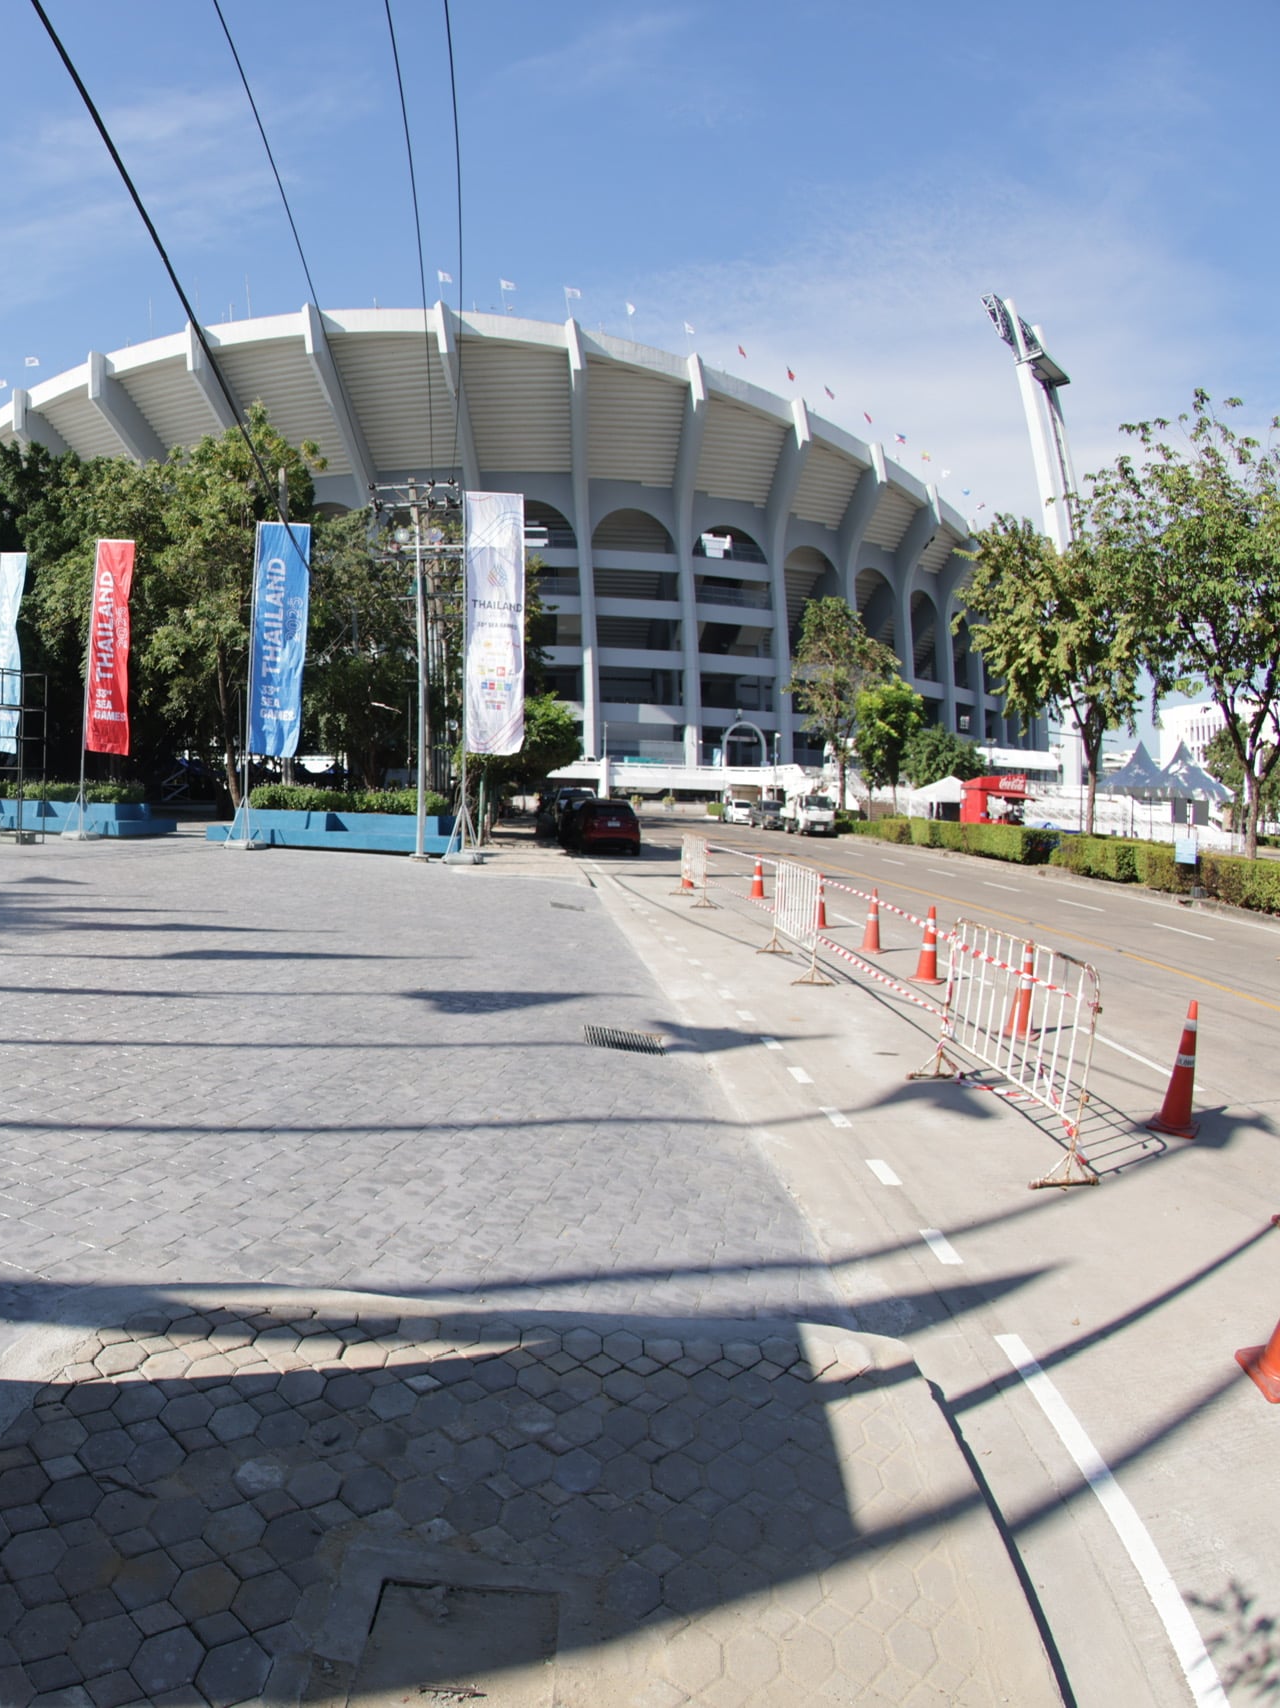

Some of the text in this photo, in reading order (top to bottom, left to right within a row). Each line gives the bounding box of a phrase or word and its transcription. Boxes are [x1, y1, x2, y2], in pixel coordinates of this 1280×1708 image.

[471, 598, 523, 613] THAILAND
[261, 557, 287, 678] THAILAND
[285, 596, 304, 643] 2025
[96, 571, 114, 682] THAILAND
[95, 699, 113, 710] SEA
[260, 696, 281, 708] SEA
[94, 709, 127, 722] GAMES
[259, 708, 297, 722] GAMES
